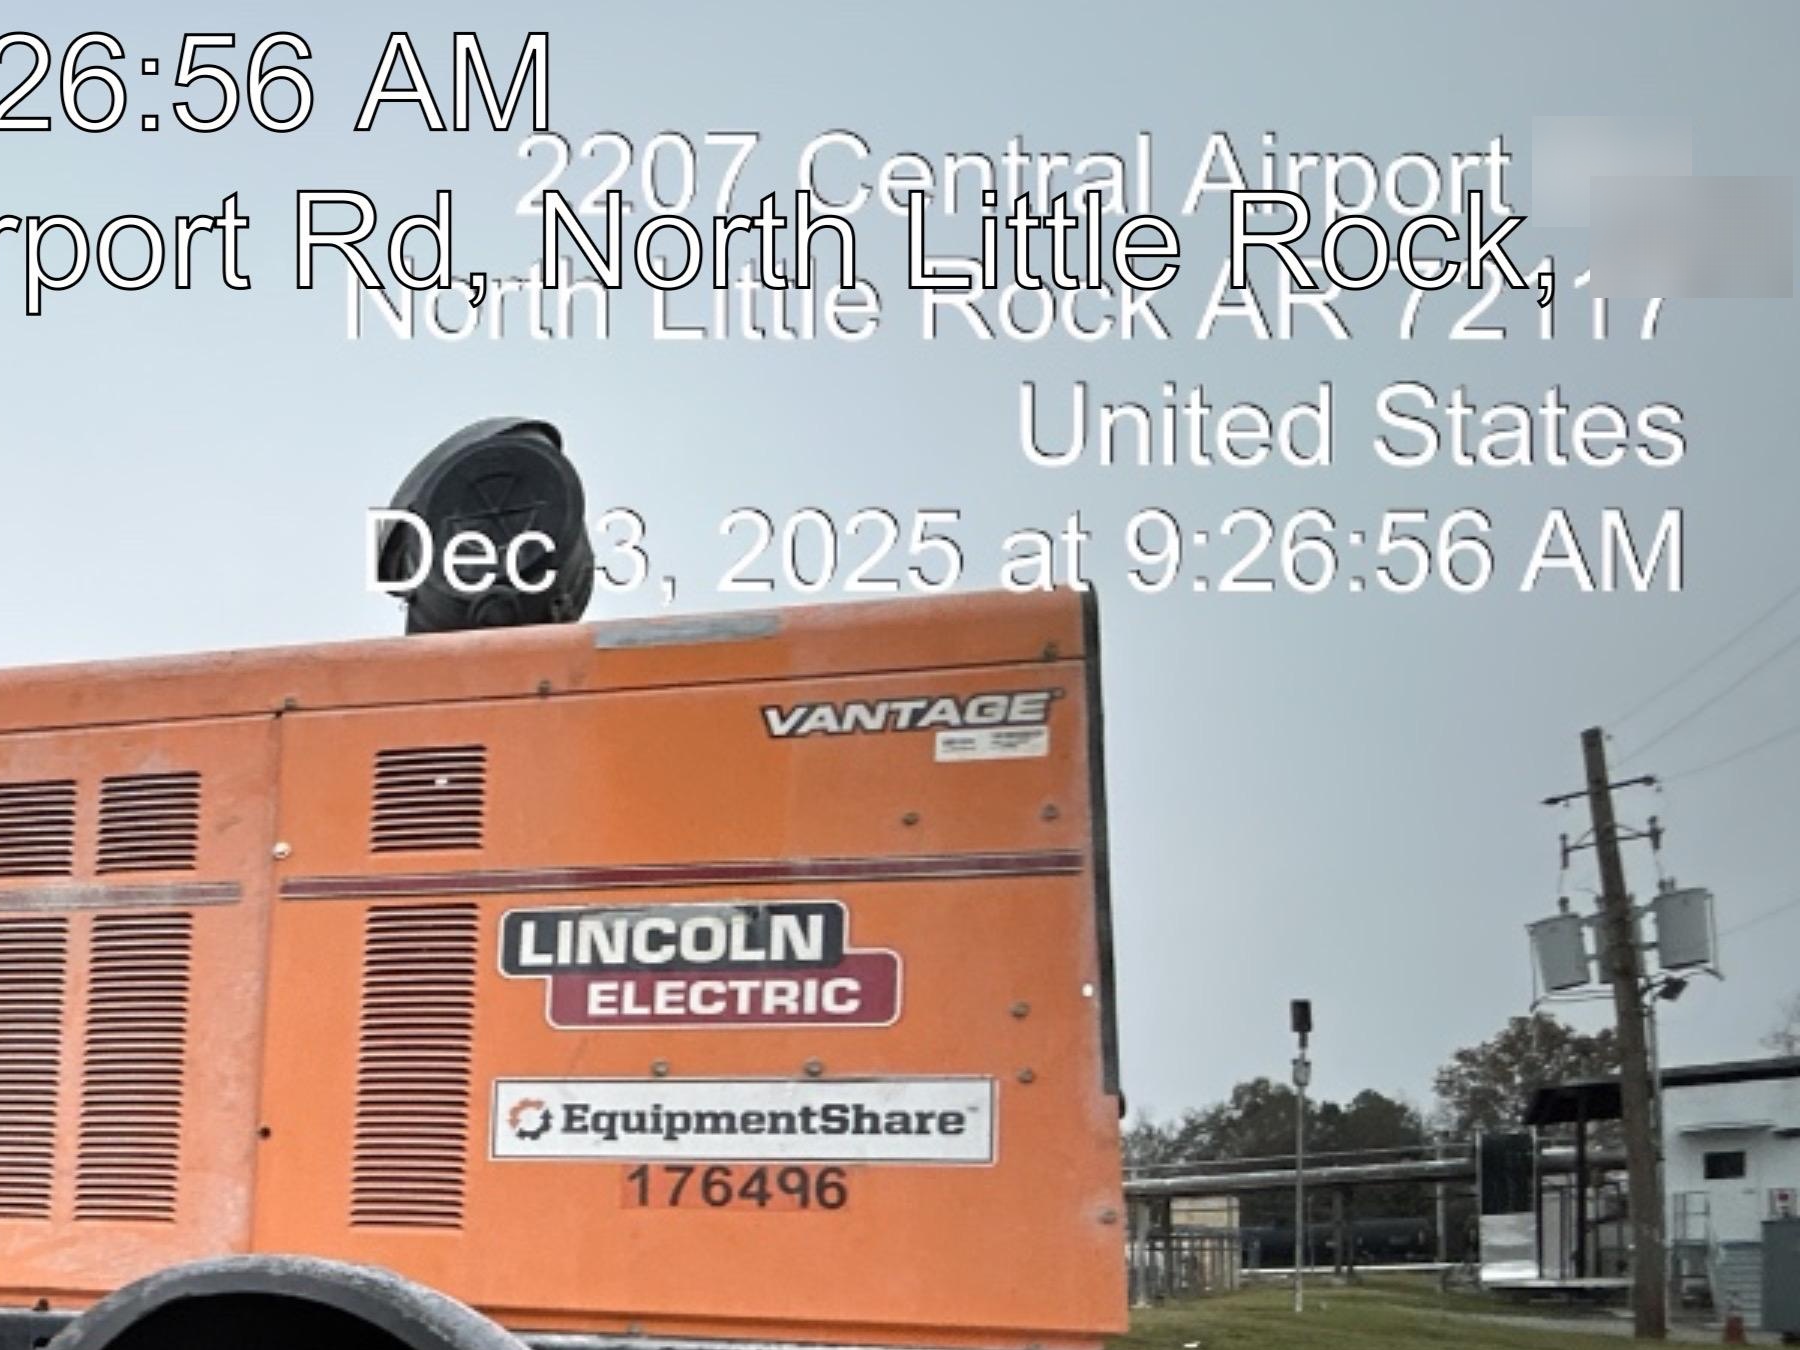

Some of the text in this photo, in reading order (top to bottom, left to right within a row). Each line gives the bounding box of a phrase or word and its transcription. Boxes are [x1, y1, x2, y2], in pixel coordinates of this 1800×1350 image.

[762, 691, 1052, 737] VANTAGE
[518, 913, 825, 967] LINCOLN
[586, 976, 864, 1017] ELECTRIC
[560, 1103, 967, 1141] EquipmentShare
[626, 1163, 850, 1210] 176496
